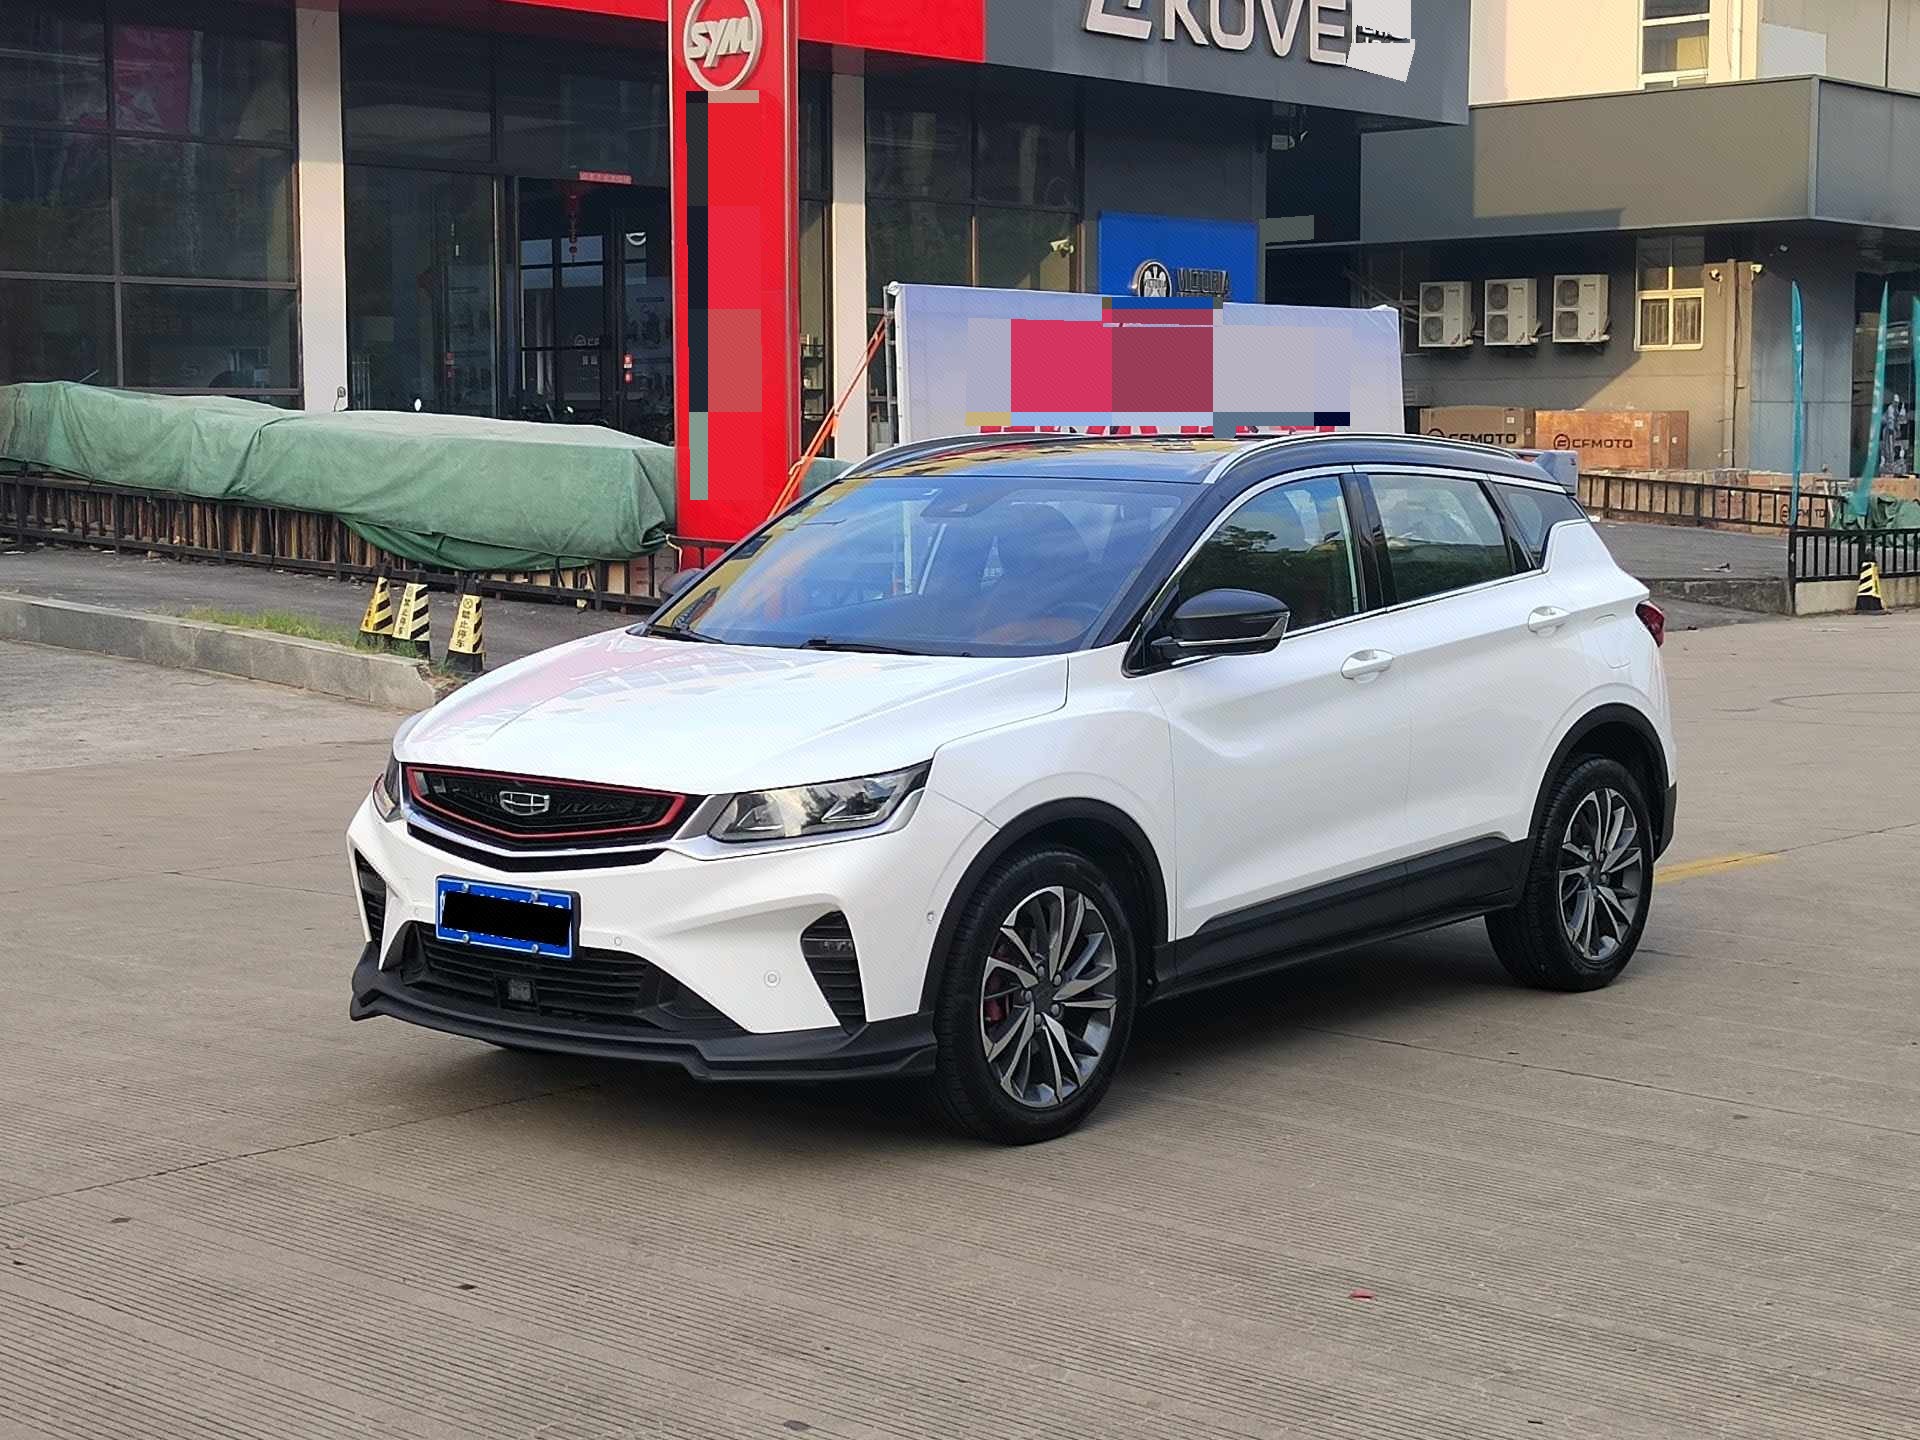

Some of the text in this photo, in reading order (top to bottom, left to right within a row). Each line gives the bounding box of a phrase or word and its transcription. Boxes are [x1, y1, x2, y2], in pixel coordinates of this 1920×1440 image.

[686, 16, 753, 68] SYM
[1162, 0, 1347, 66] KOVE
[1572, 438, 1633, 449] CFMOTO
